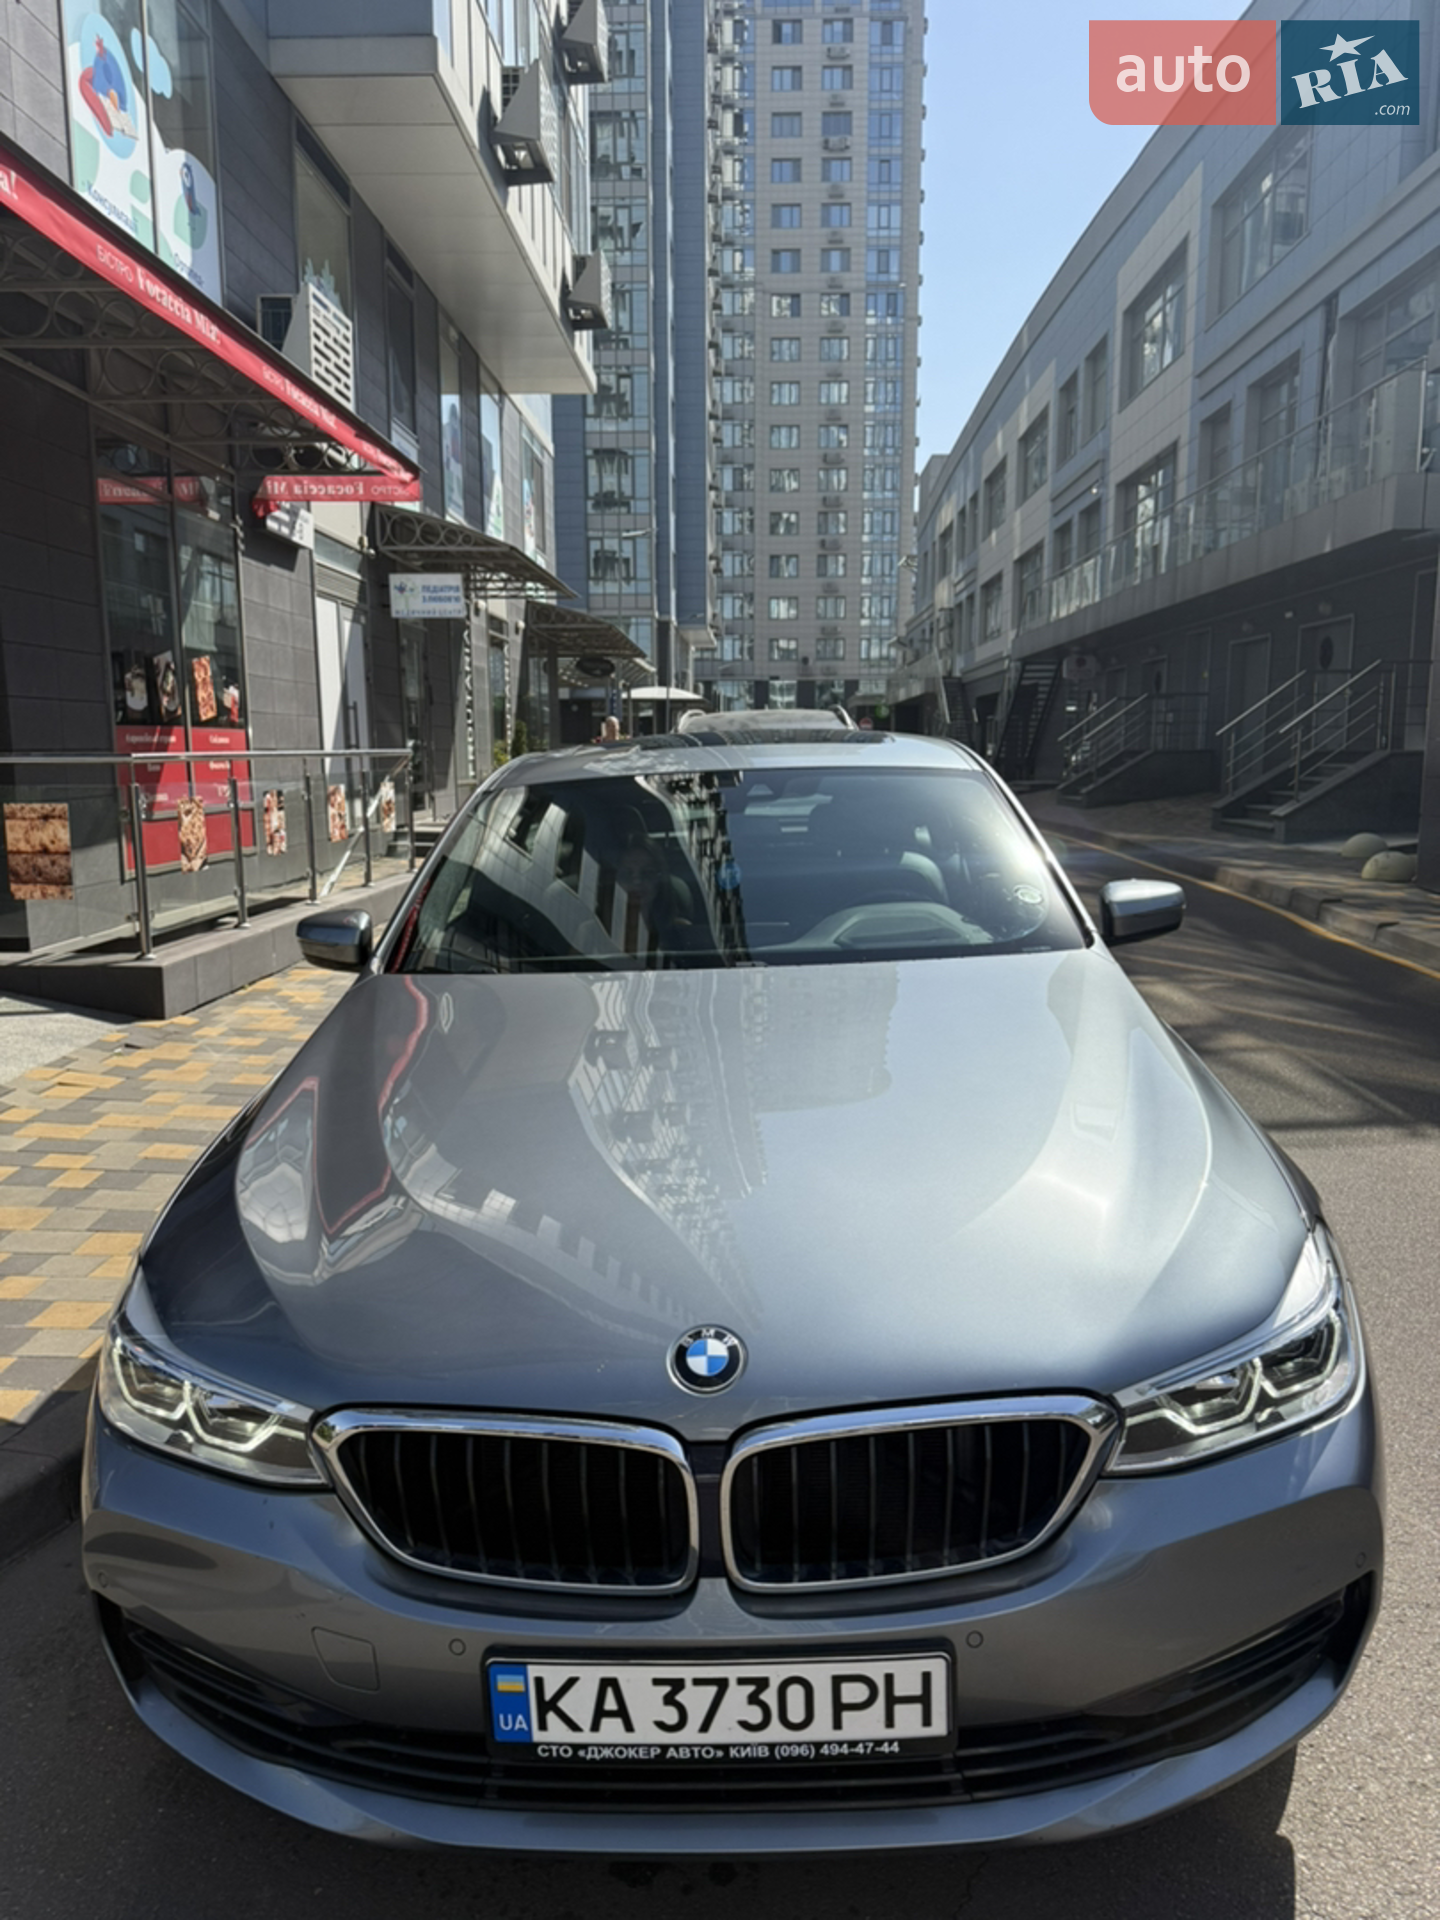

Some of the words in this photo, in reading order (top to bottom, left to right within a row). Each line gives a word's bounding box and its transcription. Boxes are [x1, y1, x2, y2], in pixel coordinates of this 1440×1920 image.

[533, 1676, 636, 1734] KA
[651, 1675, 815, 1734] 3730
[830, 1670, 934, 1731] PH
[499, 1714, 529, 1732] UA
[537, 1744, 573, 1759] СТО
[577, 1745, 661, 1760] «ДЖОКЕР
[665, 1746, 724, 1760] АВТО»
[728, 1742, 770, 1759] КИЇВ
[774, 1743, 816, 1759] (096)
[819, 1741, 900, 1757] 494-47-44
